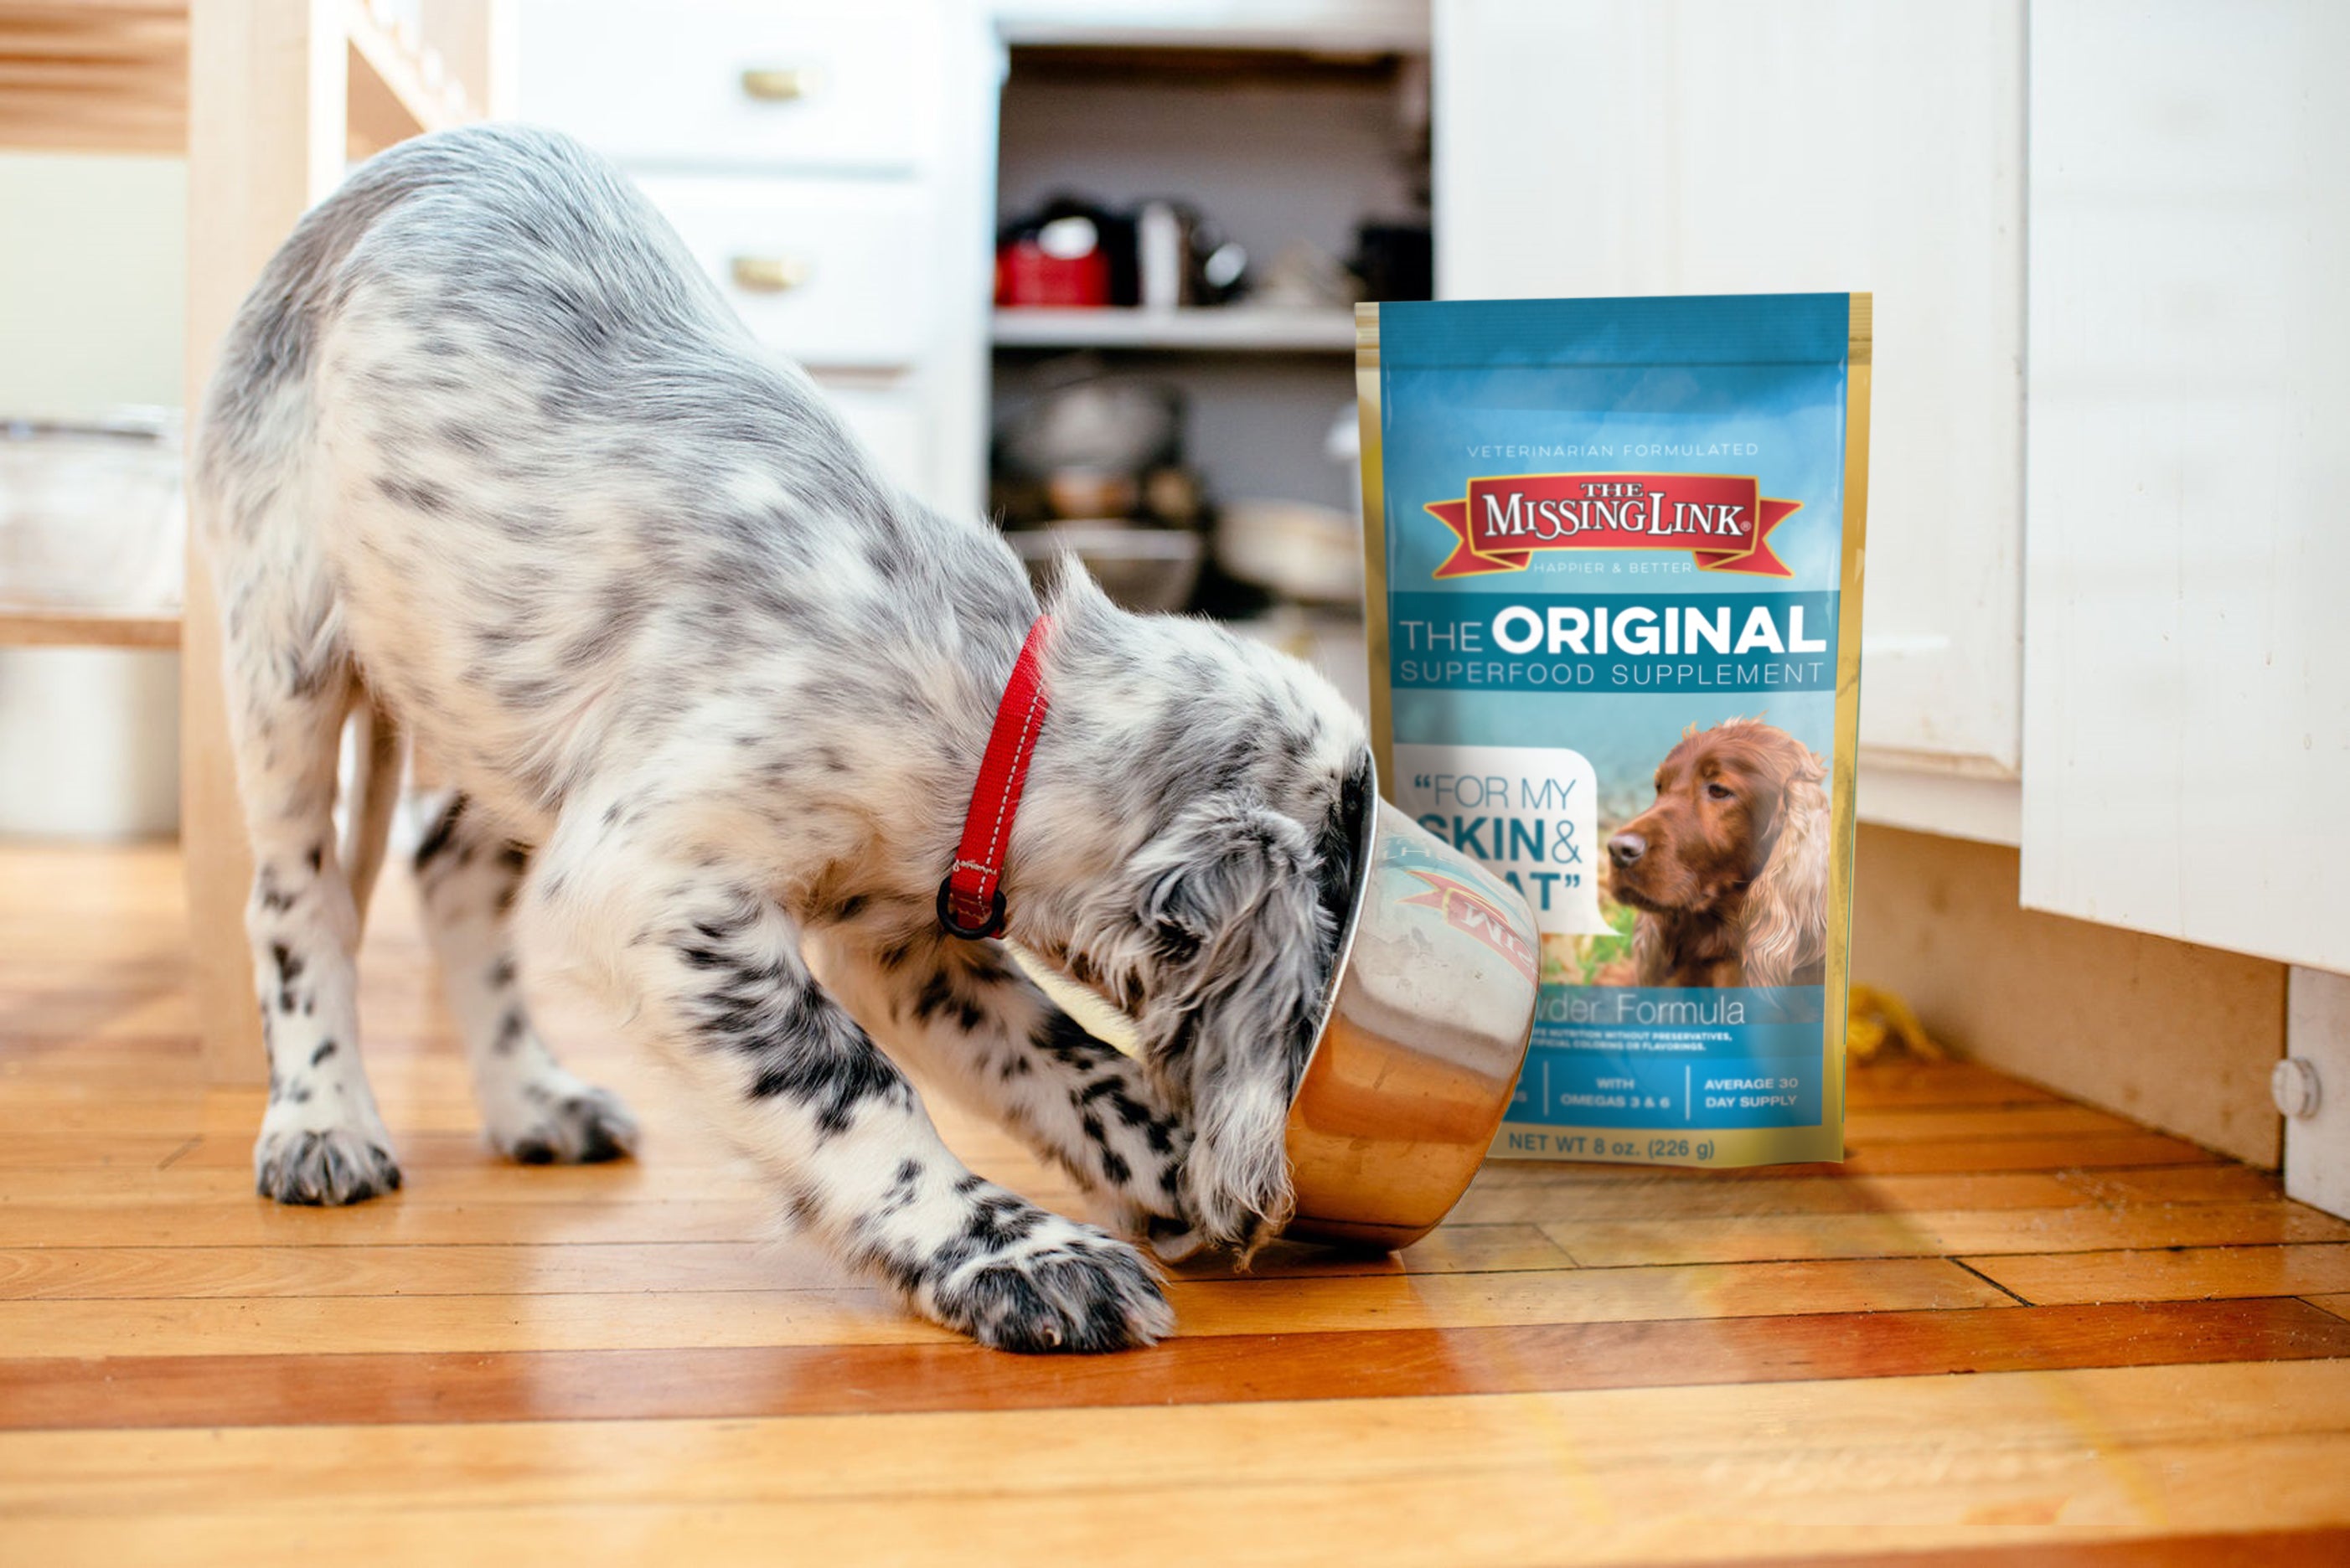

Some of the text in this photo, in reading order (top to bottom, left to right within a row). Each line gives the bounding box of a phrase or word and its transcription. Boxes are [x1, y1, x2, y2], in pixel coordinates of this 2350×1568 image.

[1467, 443, 1759, 458] VETERINARIAN FORMULATED
[1580, 482, 1644, 498] THE
[1533, 563, 1692, 574] HAPPIER & BETTER
[1399, 605, 1827, 655] THE ORIGINAL
[1400, 660, 1823, 685] SUPERFOOD SUPPLEMENT
[1521, 777, 1577, 810] MY
[1617, 993, 1745, 1024] Formula
[1604, 1031, 1650, 1040] WITHOUT
[1652, 1031, 1733, 1041] PRESERVATIVES,
[1625, 1041, 1640, 1050] OR
[1642, 1042, 1707, 1051] FLAVORINGS.
[1596, 1077, 1635, 1090] WITH
[1704, 1078, 1799, 1091] AVERAGE 30
[1560, 1094, 1671, 1108] OMEGAS 3 & 6
[1705, 1095, 1798, 1108] DAY SUPPLY
[1509, 1132, 1715, 1160] NET WT 8 oz. (226 g)
